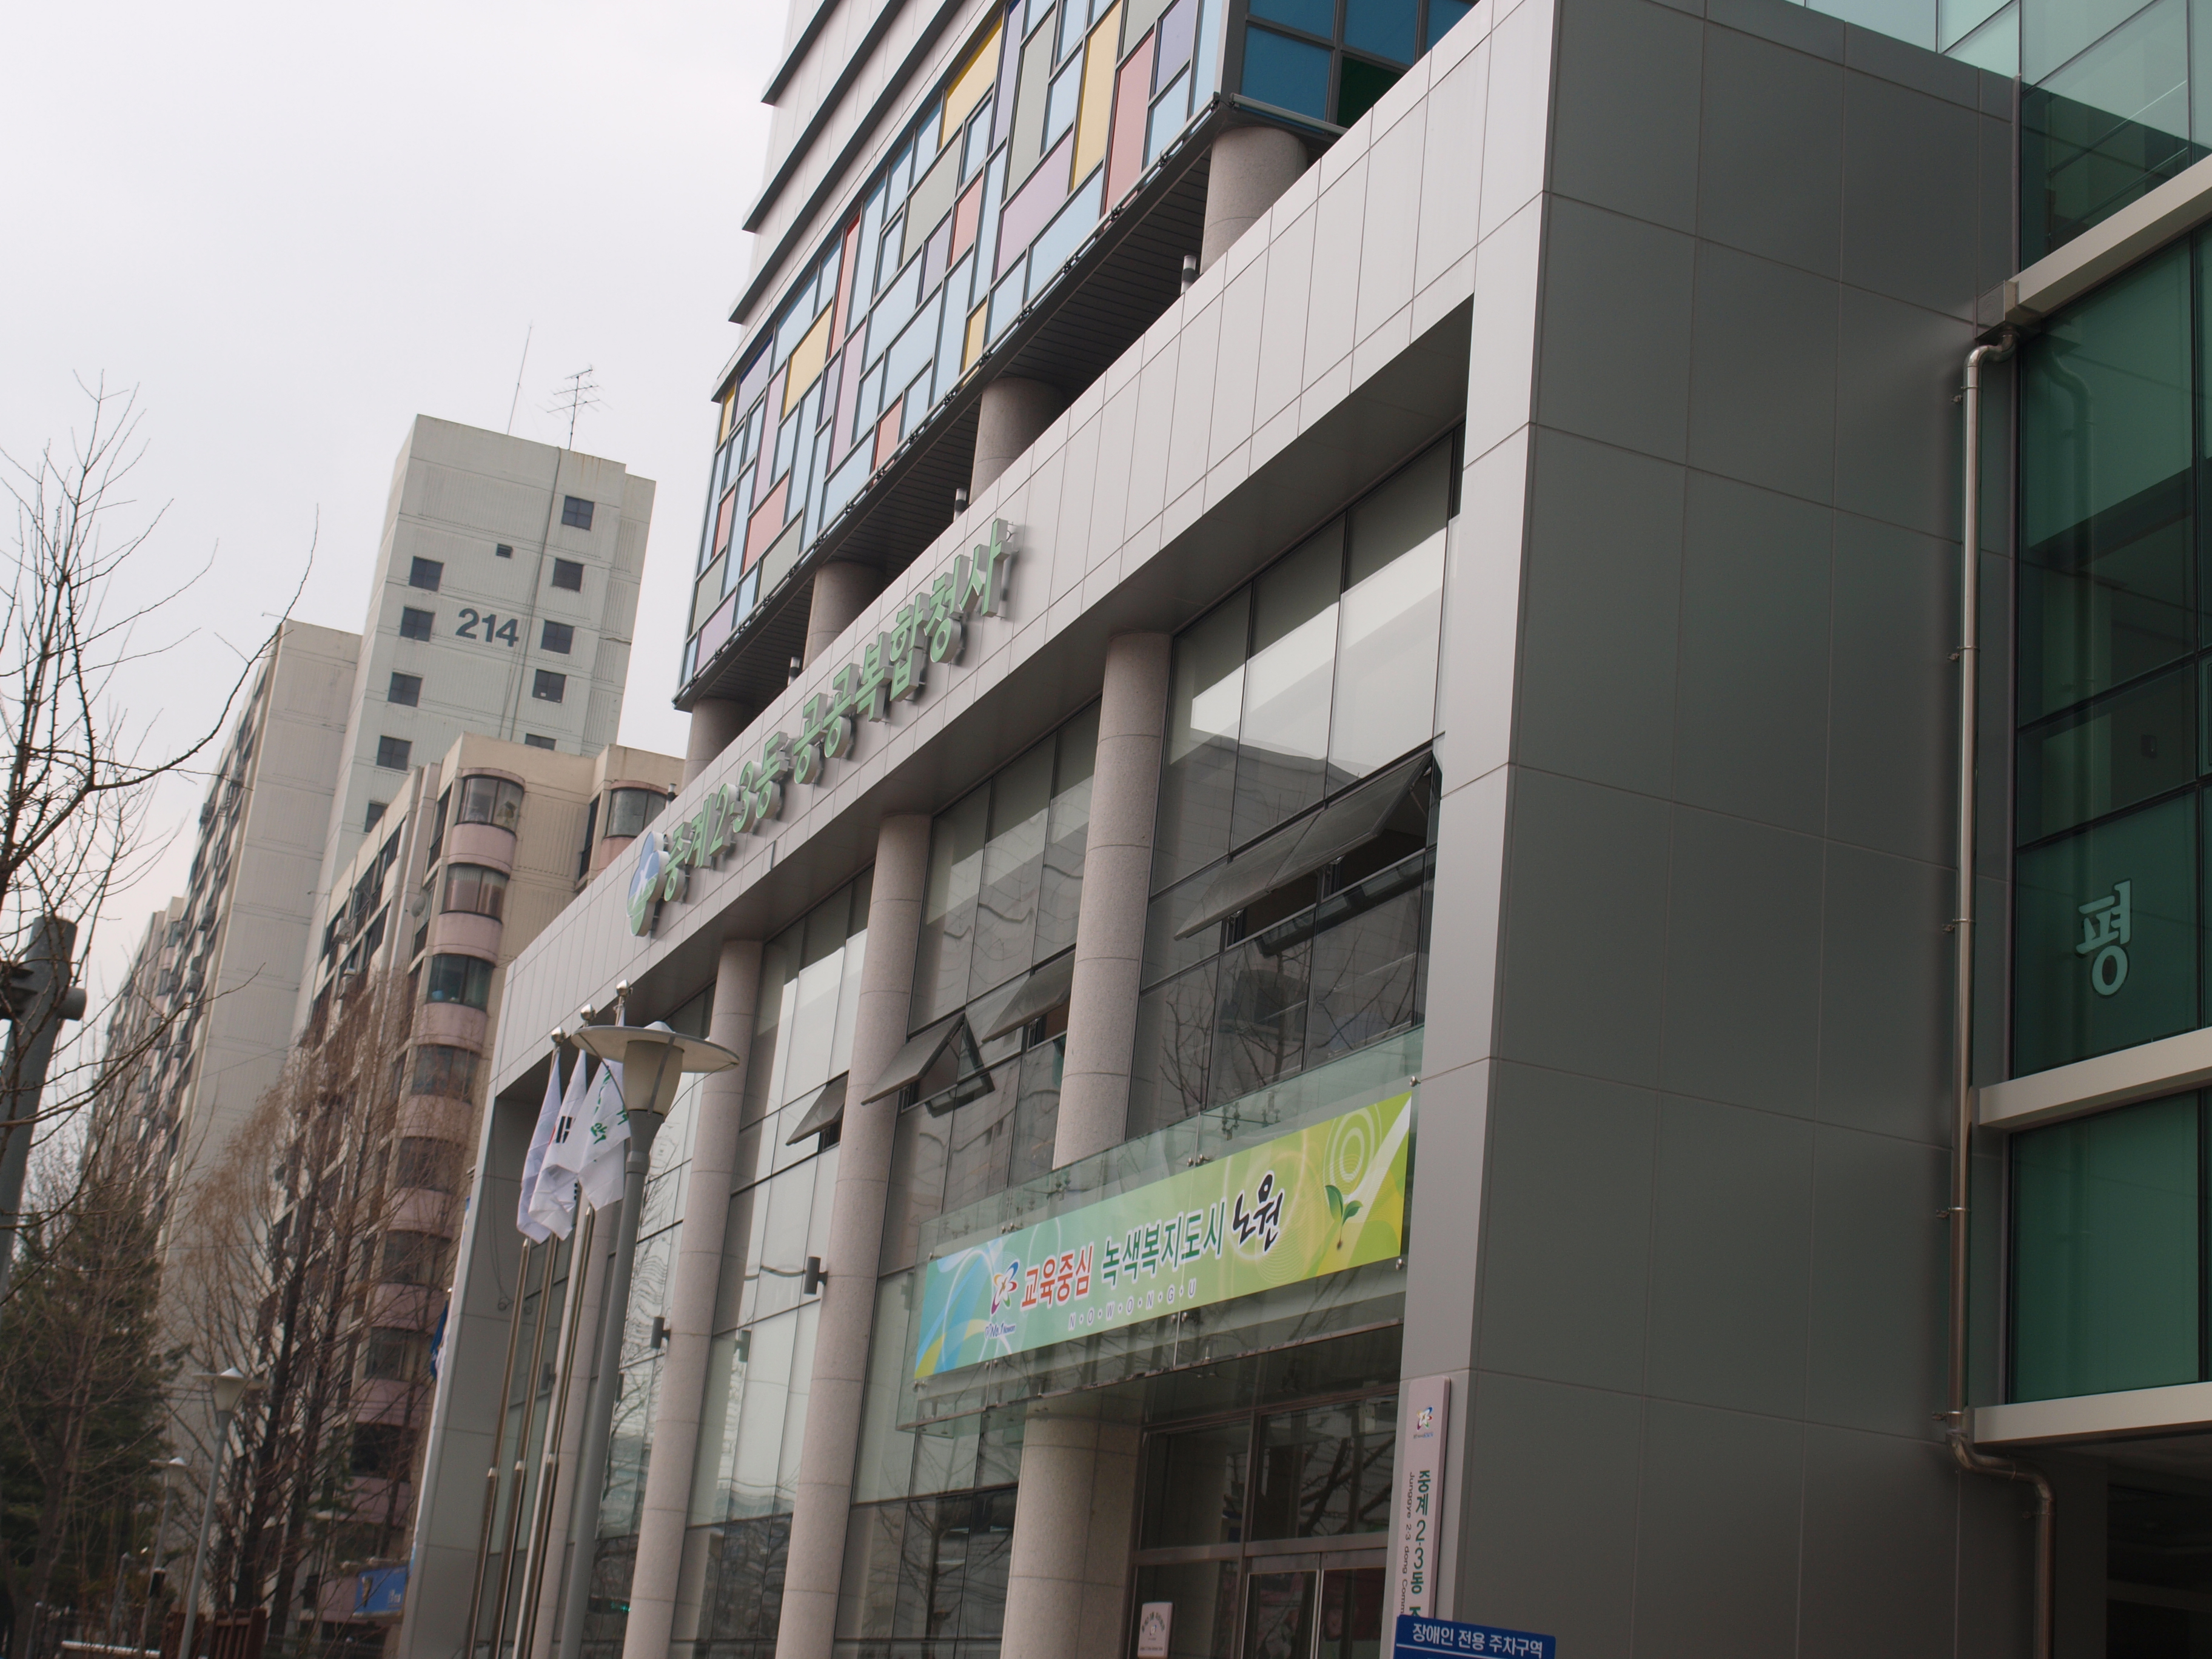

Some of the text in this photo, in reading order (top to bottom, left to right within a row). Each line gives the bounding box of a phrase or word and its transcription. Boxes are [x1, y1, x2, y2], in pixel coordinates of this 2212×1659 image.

[455, 608, 519, 647] 214
[794, 518, 1009, 784] 공공복합청사
[2076, 880, 2131, 996] 평
[1021, 1173, 1283, 1308] 교육중심 녹색복지도시 노원
[1406, 1472, 1415, 1518] Junggye
[1412, 1623, 1543, 1659] 장애인 전용 주차구역
